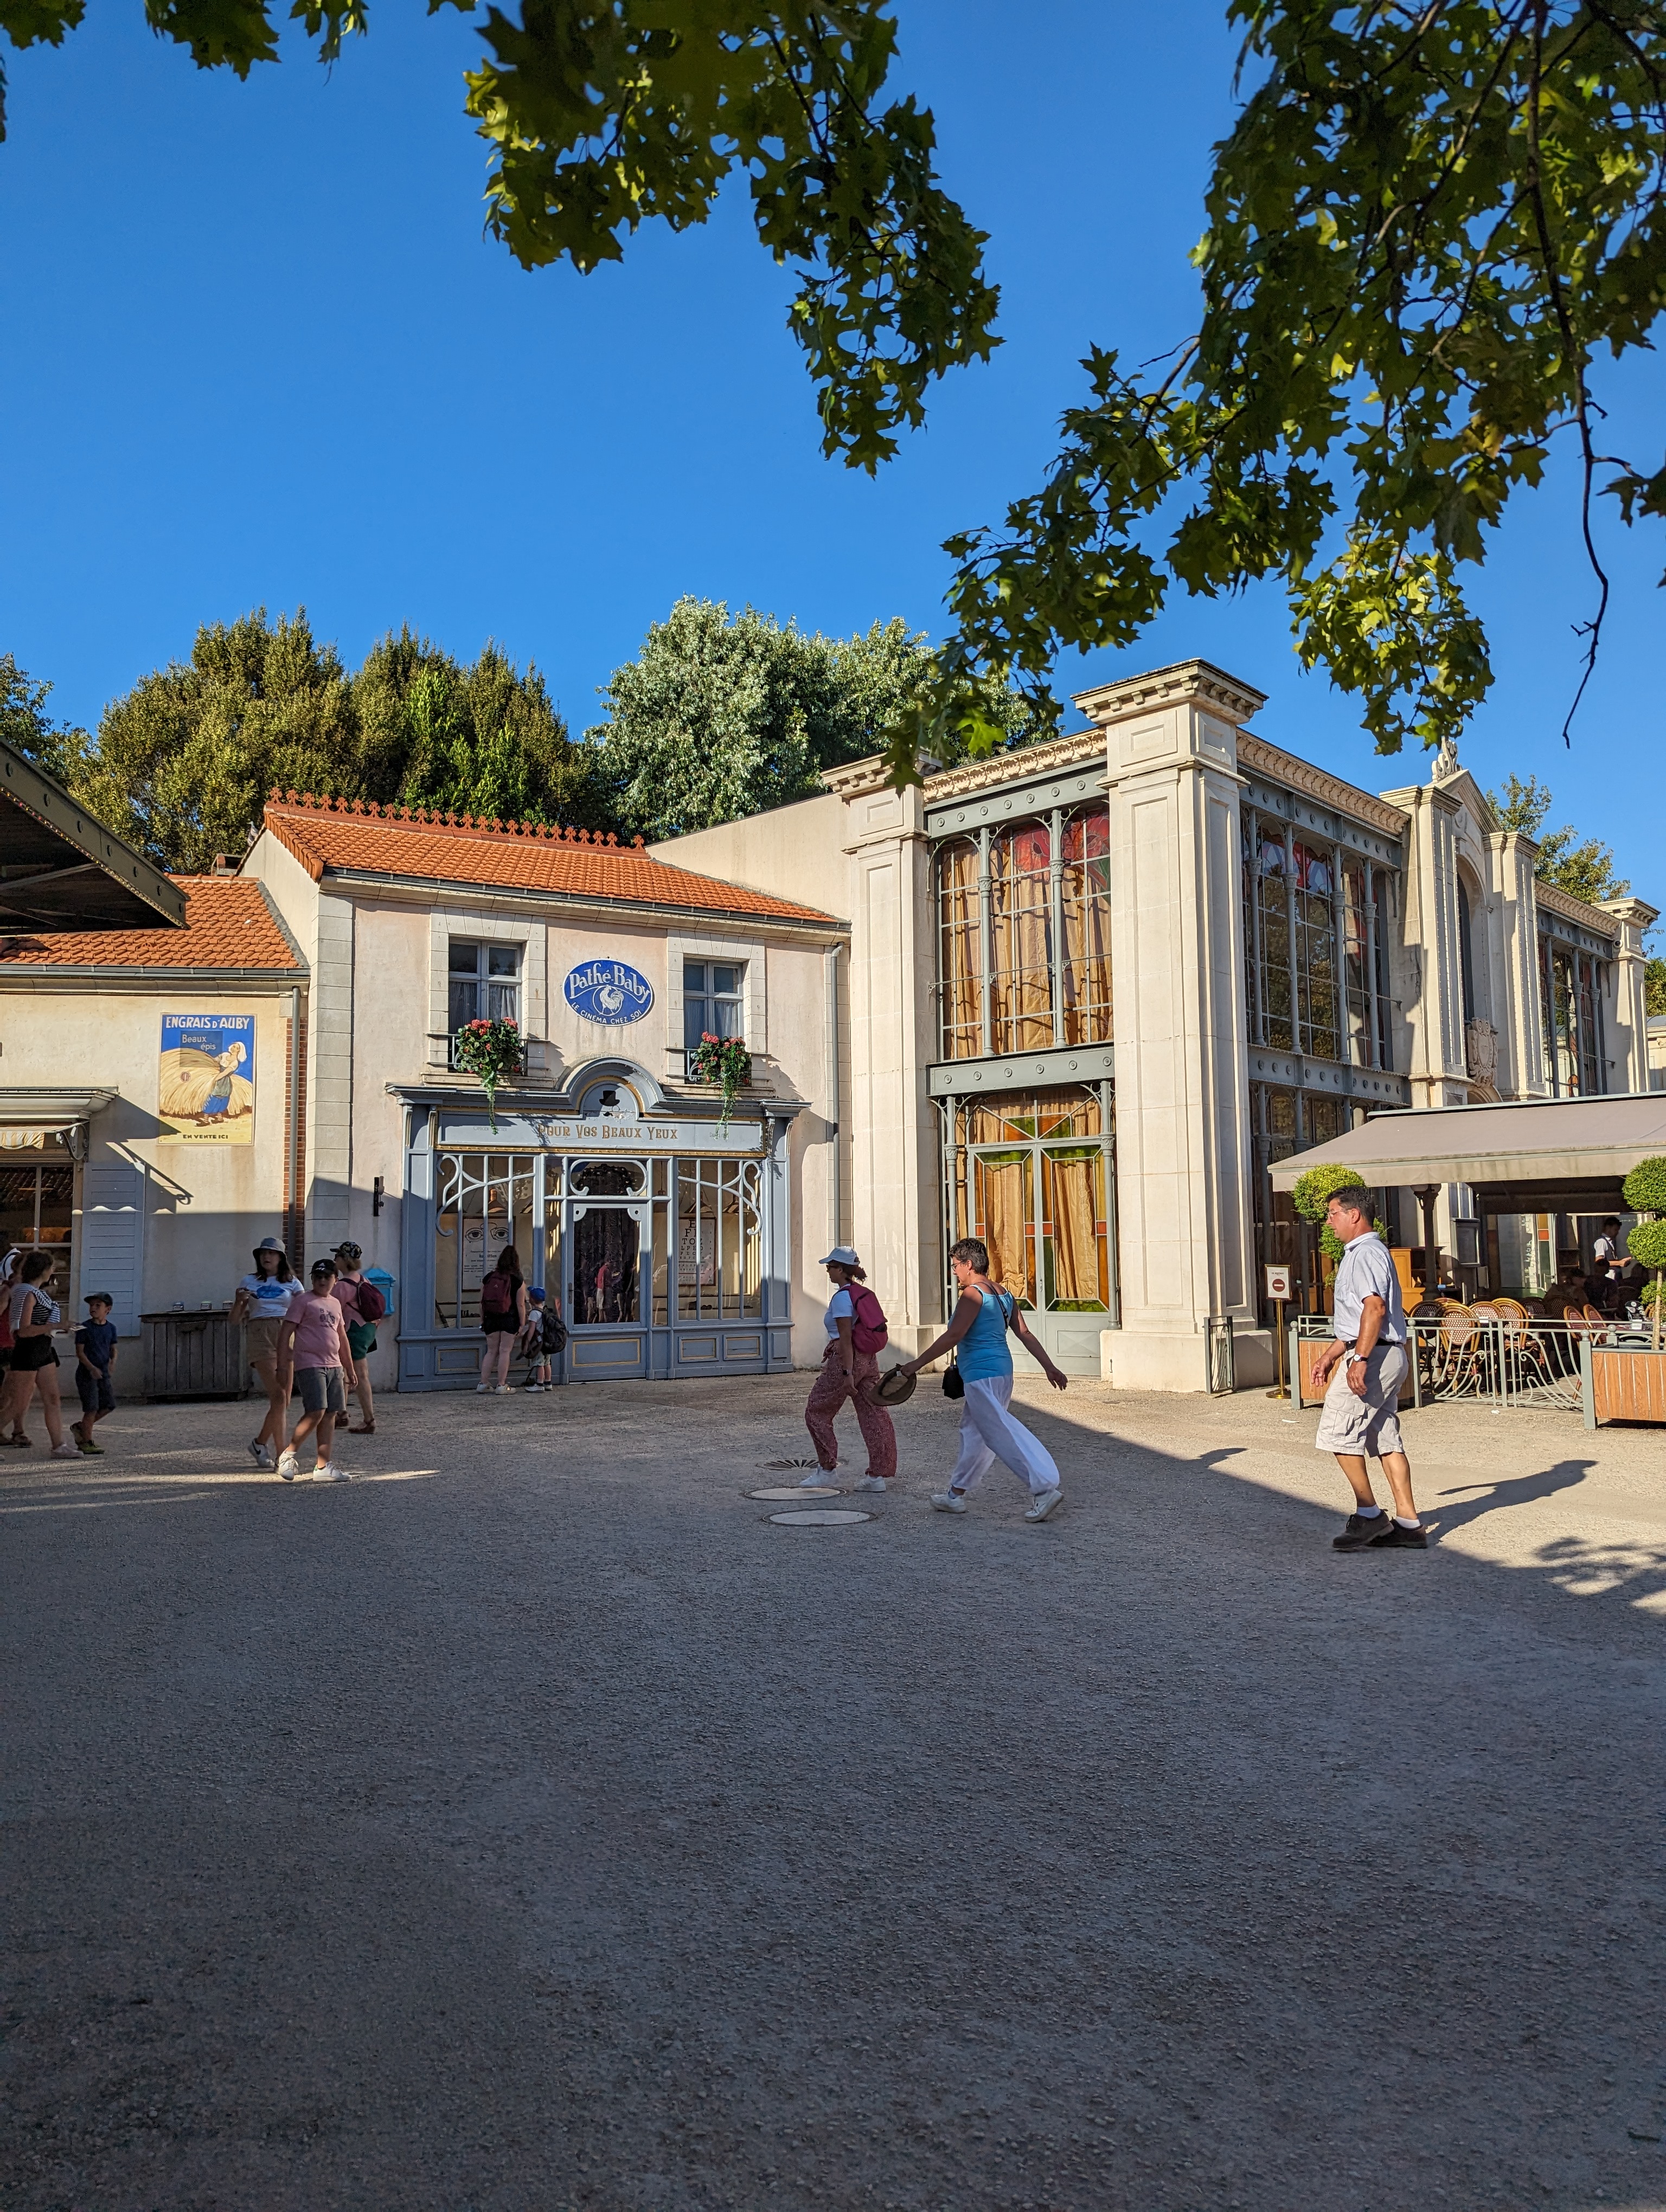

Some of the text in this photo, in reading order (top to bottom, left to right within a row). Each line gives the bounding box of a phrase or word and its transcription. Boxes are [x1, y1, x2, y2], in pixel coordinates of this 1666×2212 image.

[571, 1002, 580, 1011] LE
[580, 1009, 607, 1024] CINÉMA
[630, 1009, 642, 1020] SOI
[165, 1017, 249, 1030] ENGRAIS D'AUBY
[182, 1034, 207, 1043] Beaux
[201, 1043, 216, 1051] épis
